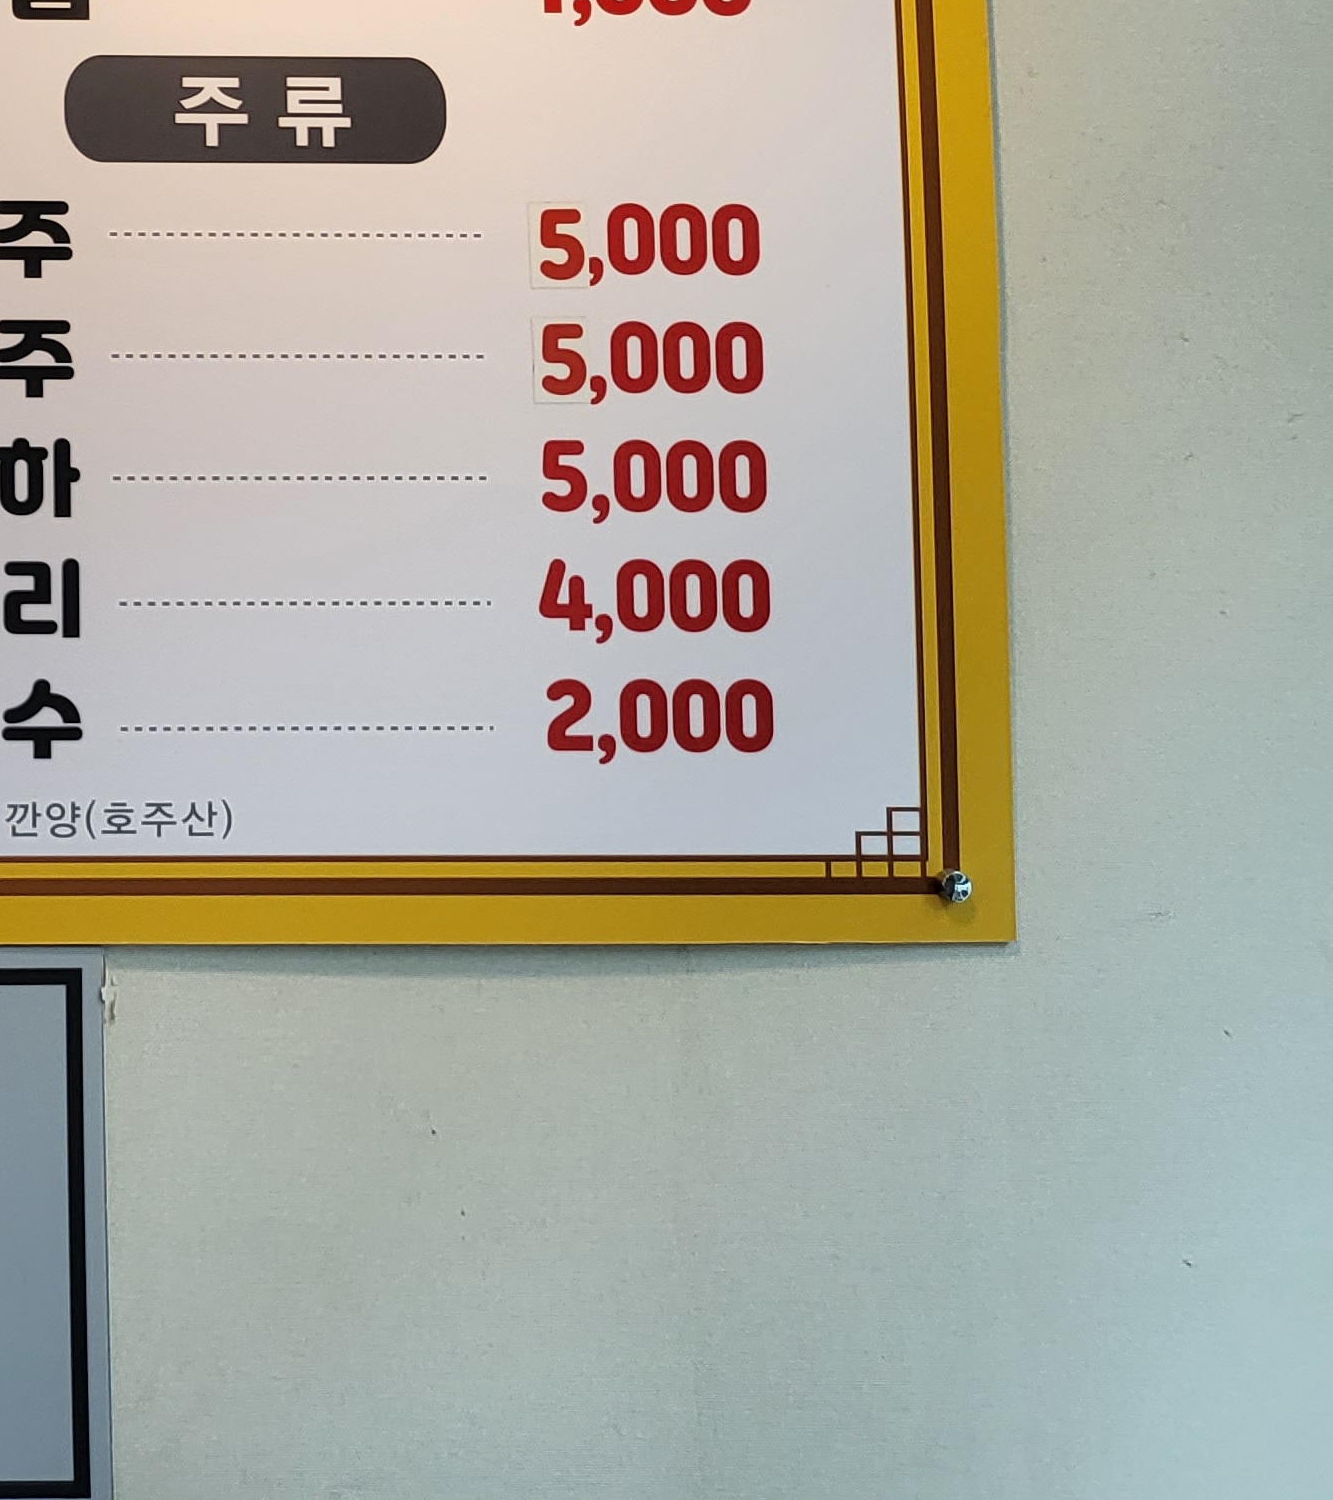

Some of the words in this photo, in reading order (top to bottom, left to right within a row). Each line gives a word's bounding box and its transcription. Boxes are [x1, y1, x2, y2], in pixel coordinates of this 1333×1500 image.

[539, 202, 761, 287] 5,000
[541, 320, 764, 405] 5,000
[541, 439, 768, 525] 5,000
[538, 558, 771, 645] 4,000
[546, 678, 774, 765] 2,000
[5, 799, 232, 840] 깐양(호주산)
